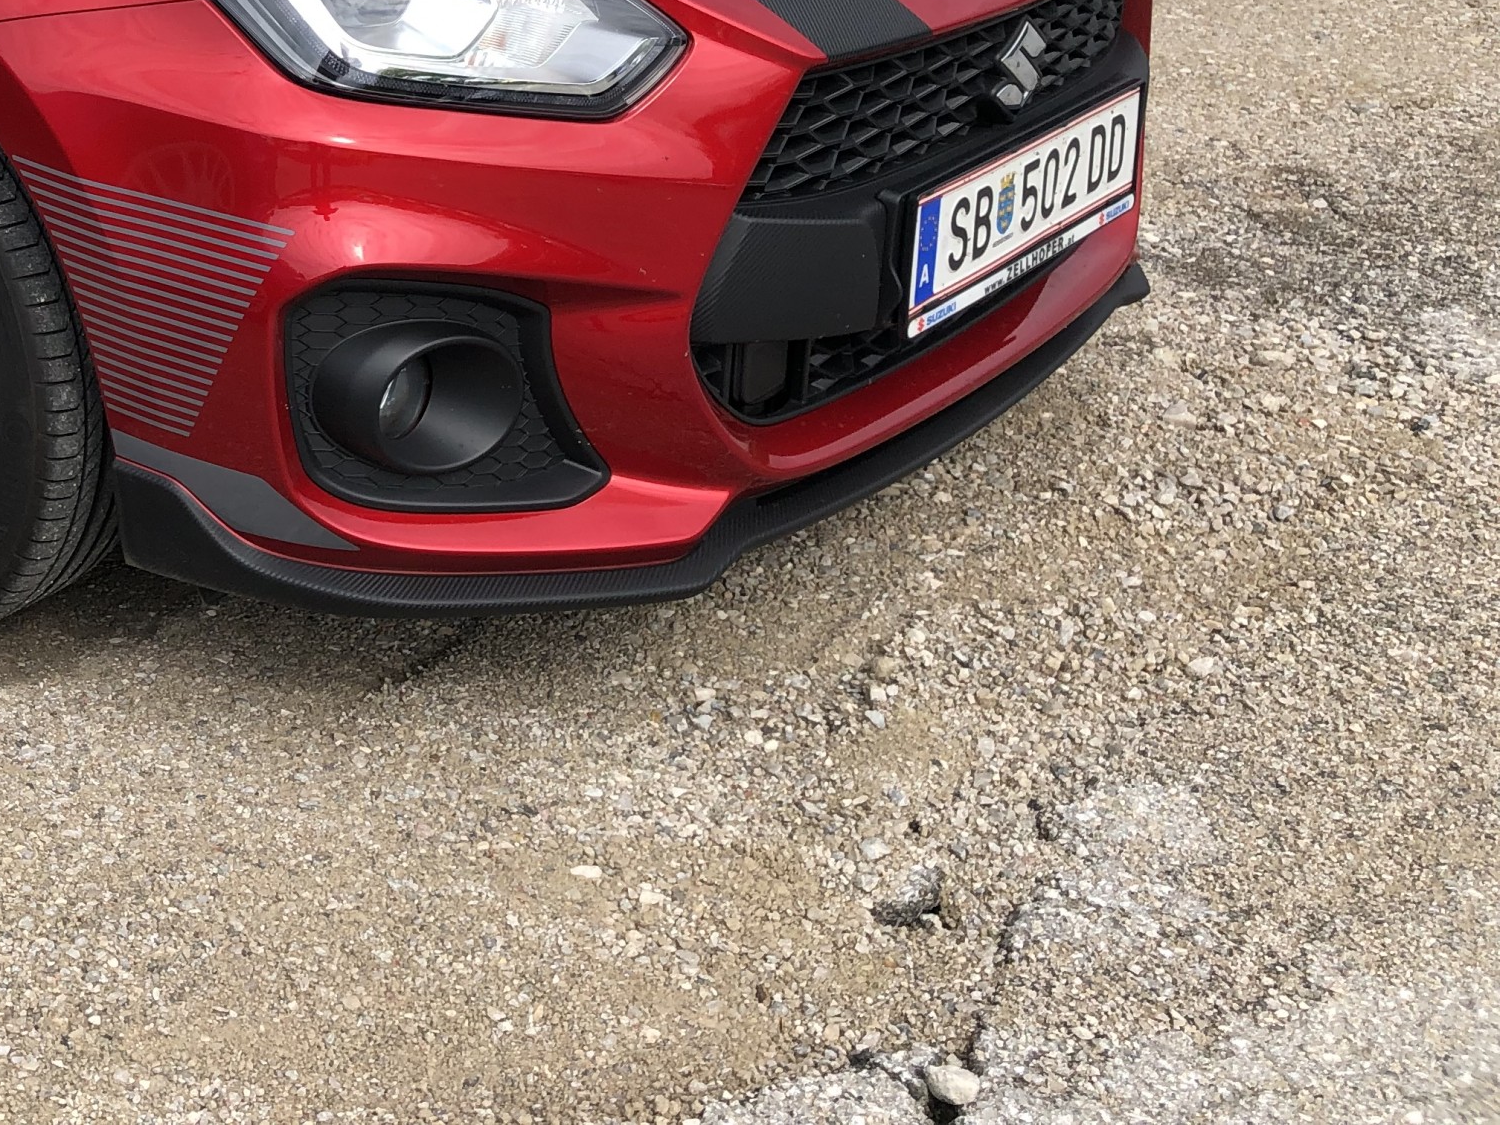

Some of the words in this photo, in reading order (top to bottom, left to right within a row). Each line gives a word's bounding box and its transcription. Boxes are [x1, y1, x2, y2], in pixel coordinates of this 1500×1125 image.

[948, 185, 994, 272] SB
[1020, 137, 1081, 232] 502
[1087, 114, 1126, 195] DD
[1105, 200, 1130, 221] SUZUKI
[919, 263, 930, 288] A
[926, 301, 957, 326] SUZUKI
